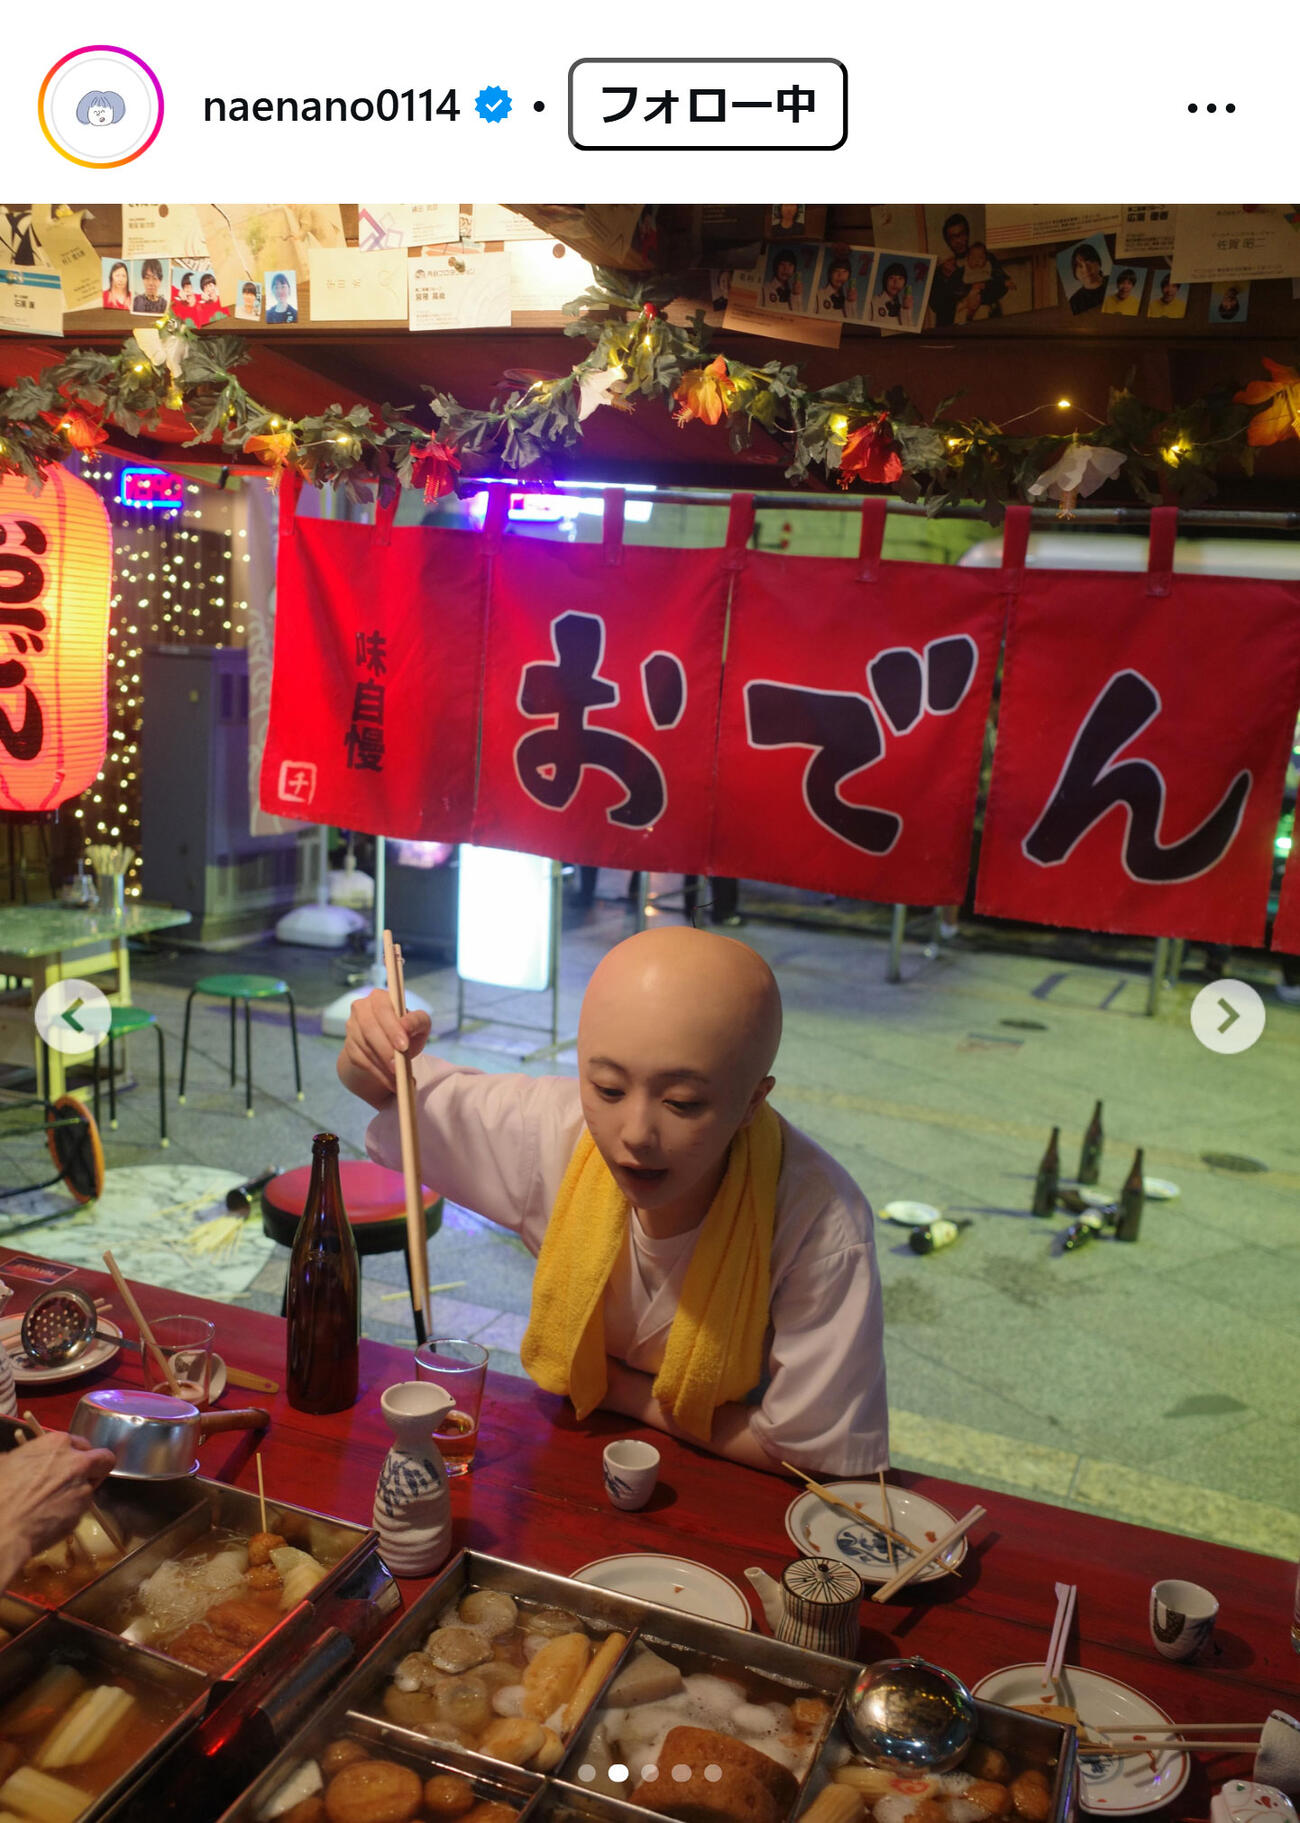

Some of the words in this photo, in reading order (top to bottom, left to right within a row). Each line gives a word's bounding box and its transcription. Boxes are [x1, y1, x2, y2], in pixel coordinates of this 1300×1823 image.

[344, 630, 387, 772] 味自慢
[513, 609, 1253, 884] おでん
